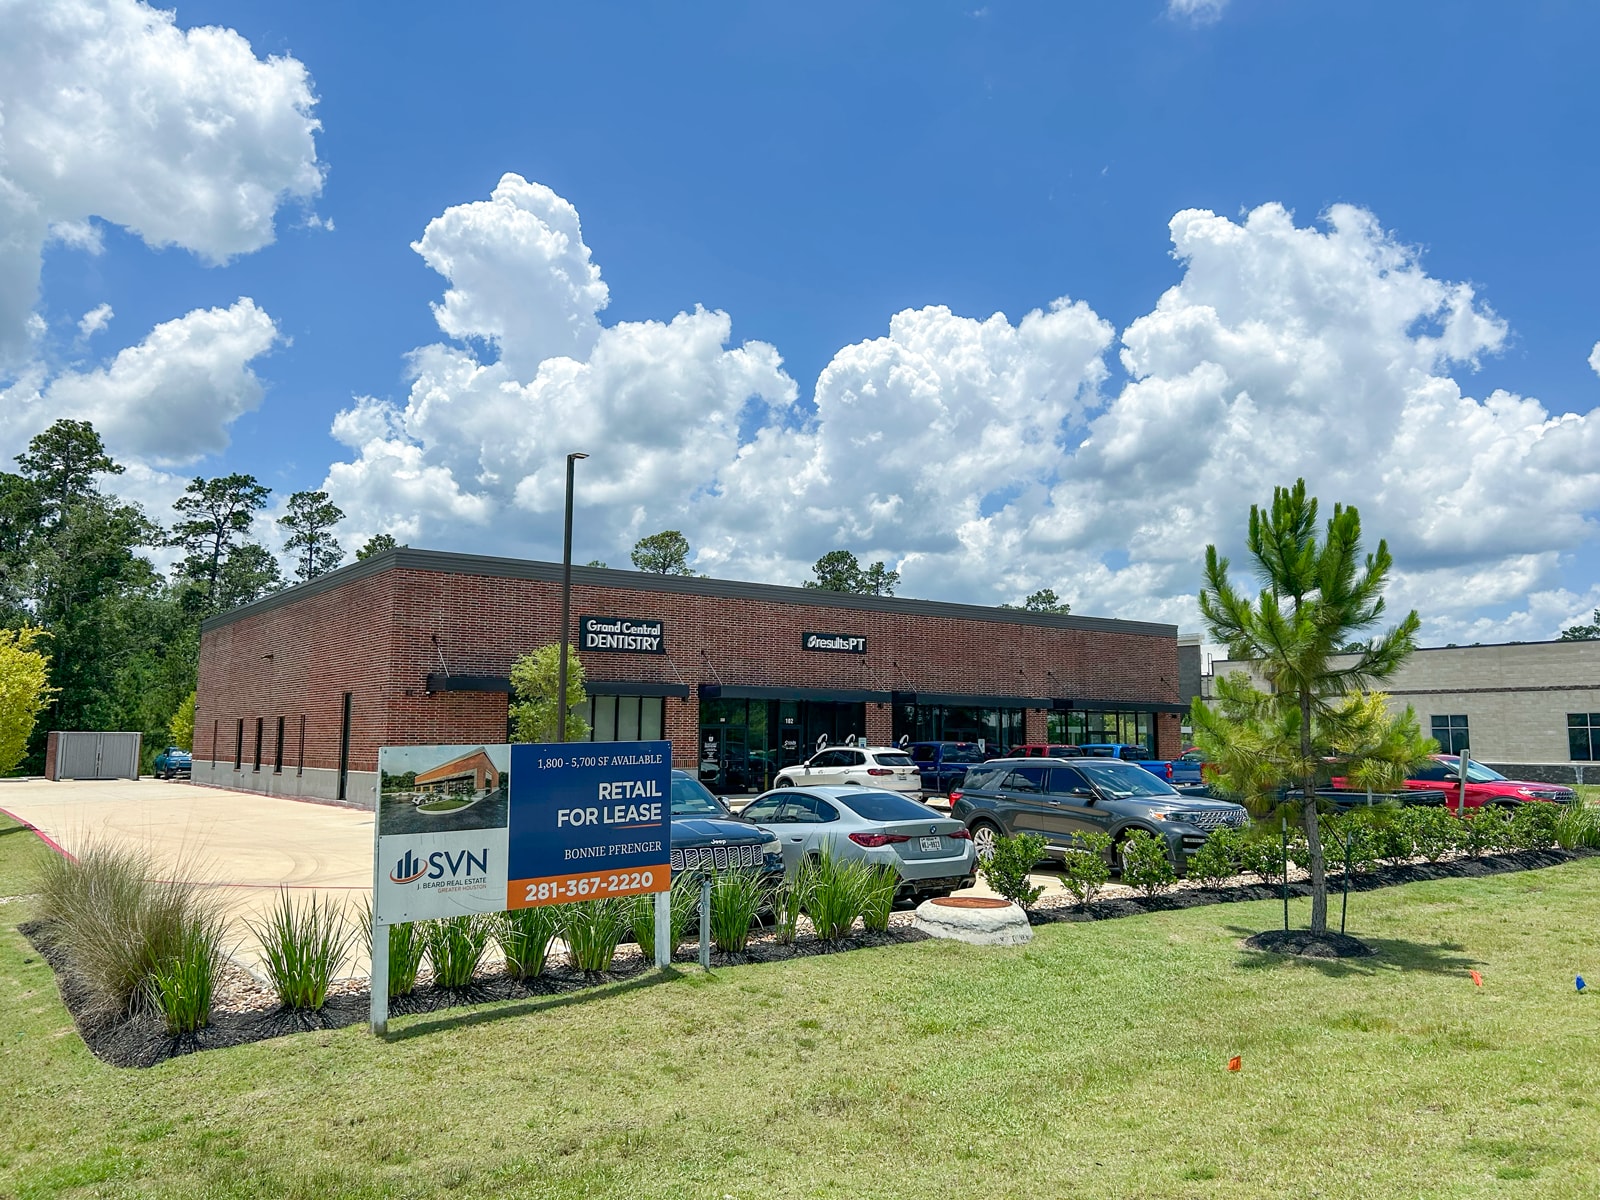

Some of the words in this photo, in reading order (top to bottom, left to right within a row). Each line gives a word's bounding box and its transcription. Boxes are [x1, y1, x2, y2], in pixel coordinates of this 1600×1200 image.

[586, 619, 621, 633] Grand
[622, 622, 661, 636] Central
[586, 633, 660, 651] DENTISTRY
[538, 757, 563, 770] 1,800
[571, 756, 596, 769] 5,700
[598, 756, 609, 766] SF
[611, 754, 663, 766] AVAILABLE
[598, 780, 662, 800] RETAIL
[557, 807, 598, 827] FOR
[603, 803, 662, 824] LEASE
[564, 845, 606, 860] BONNIE
[608, 841, 662, 855] PFRENGER
[428, 848, 487, 879] SVN
[422, 881, 446, 889] BEARD
[446, 879, 463, 887] REAL
[464, 877, 487, 885] ESTATE
[525, 871, 654, 901] 281-367-2220
